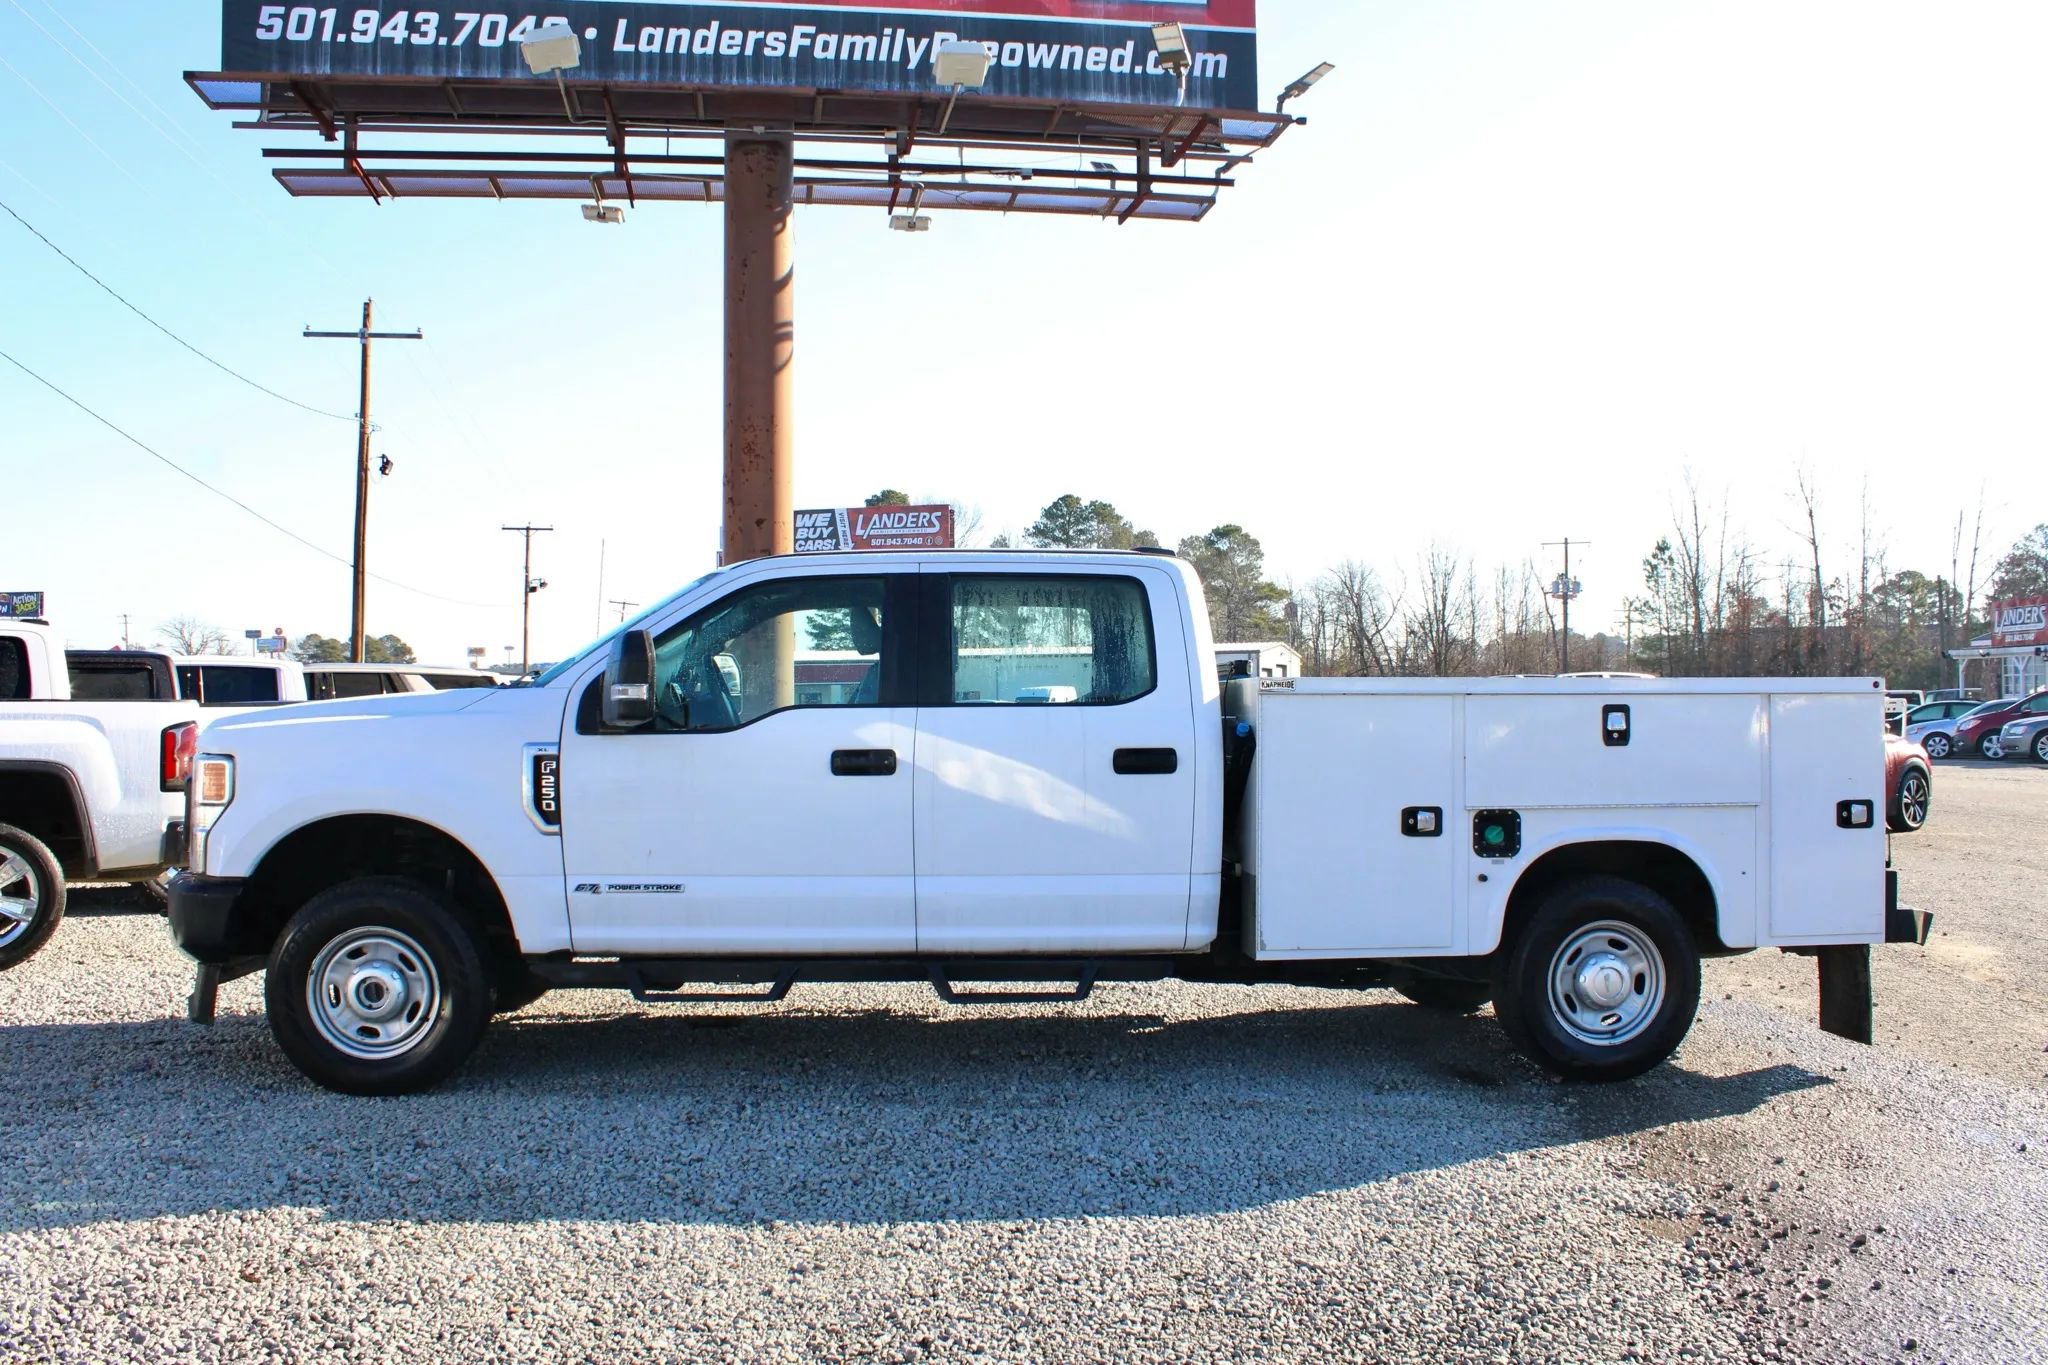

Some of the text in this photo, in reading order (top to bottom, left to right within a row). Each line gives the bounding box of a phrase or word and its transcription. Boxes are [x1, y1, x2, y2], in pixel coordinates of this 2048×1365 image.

[613, 17, 1228, 78] LandersFamilyPeowned.cm
[795, 512, 832, 527] WE
[856, 511, 941, 539] LANDERS
[795, 527, 834, 539] BUY
[795, 539, 836, 551] CARS!
[1994, 606, 2047, 637] LANDERS
[1261, 680, 1295, 689] KNAPHEIDE
